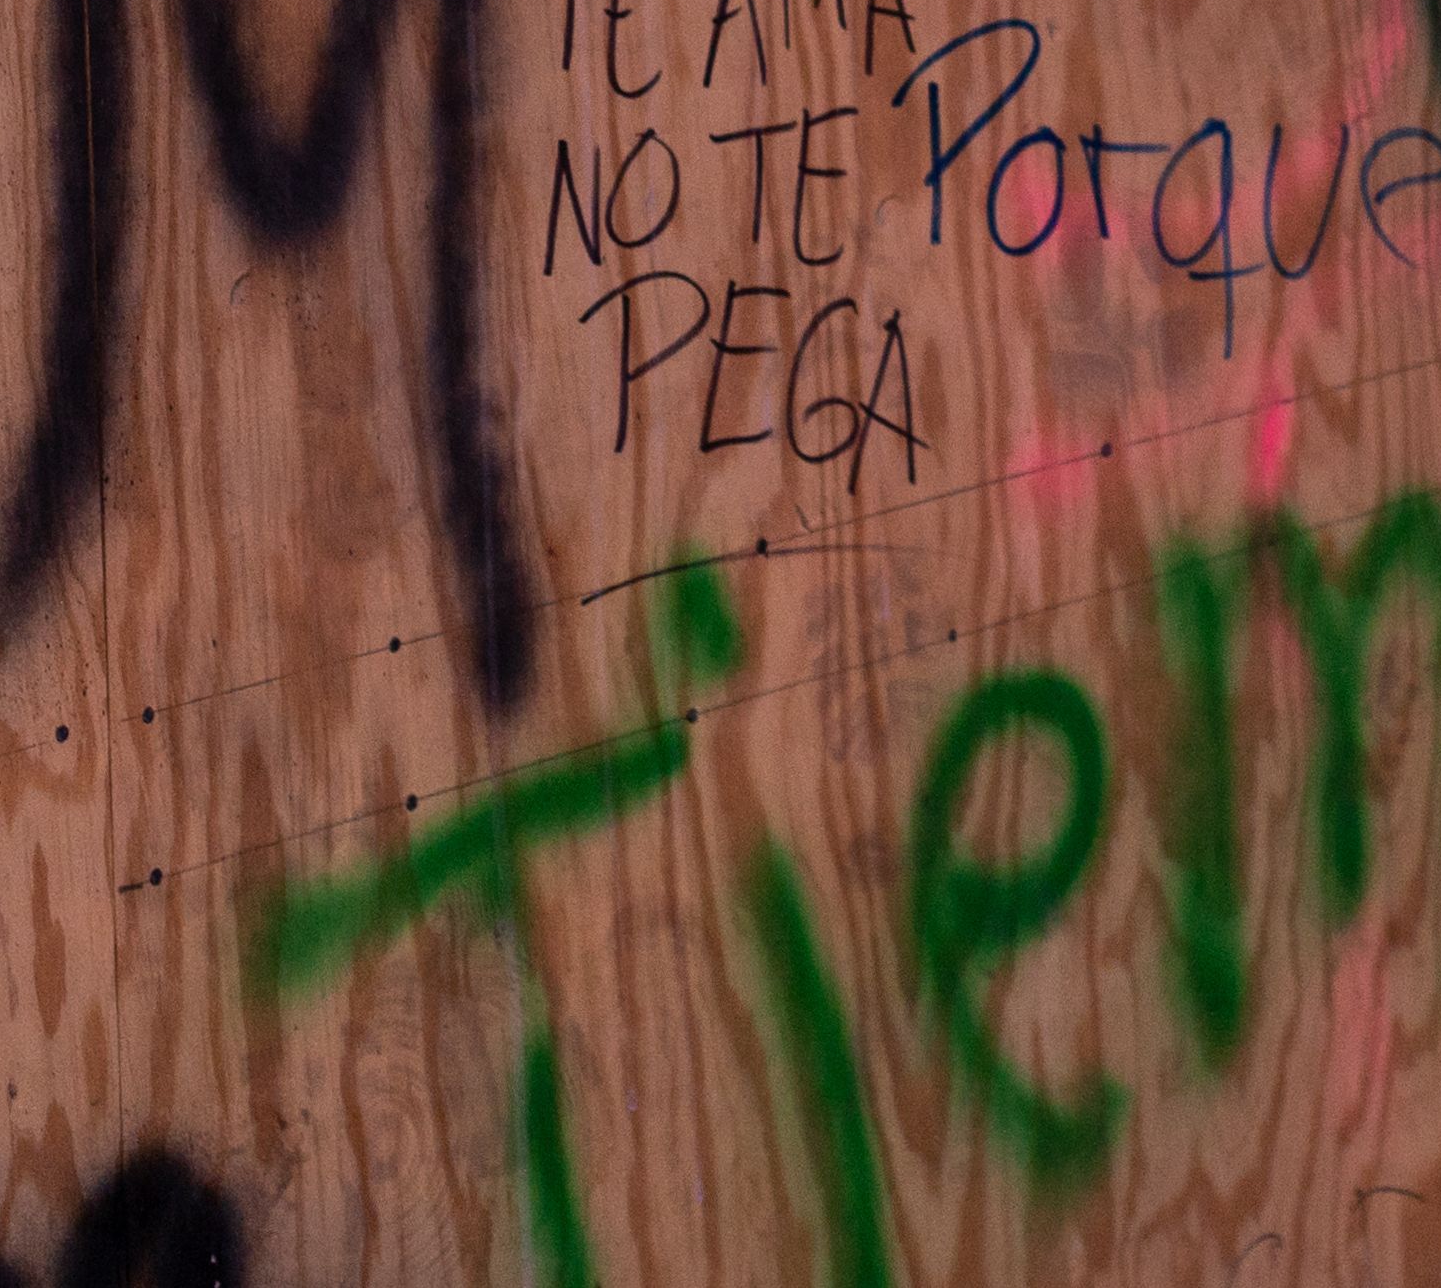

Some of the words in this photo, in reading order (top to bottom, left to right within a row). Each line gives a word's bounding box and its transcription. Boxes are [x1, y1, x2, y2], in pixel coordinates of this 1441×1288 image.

[541, 125, 682, 279] NO
[706, 105, 862, 267] TE
[576, 268, 932, 497] PEGA
